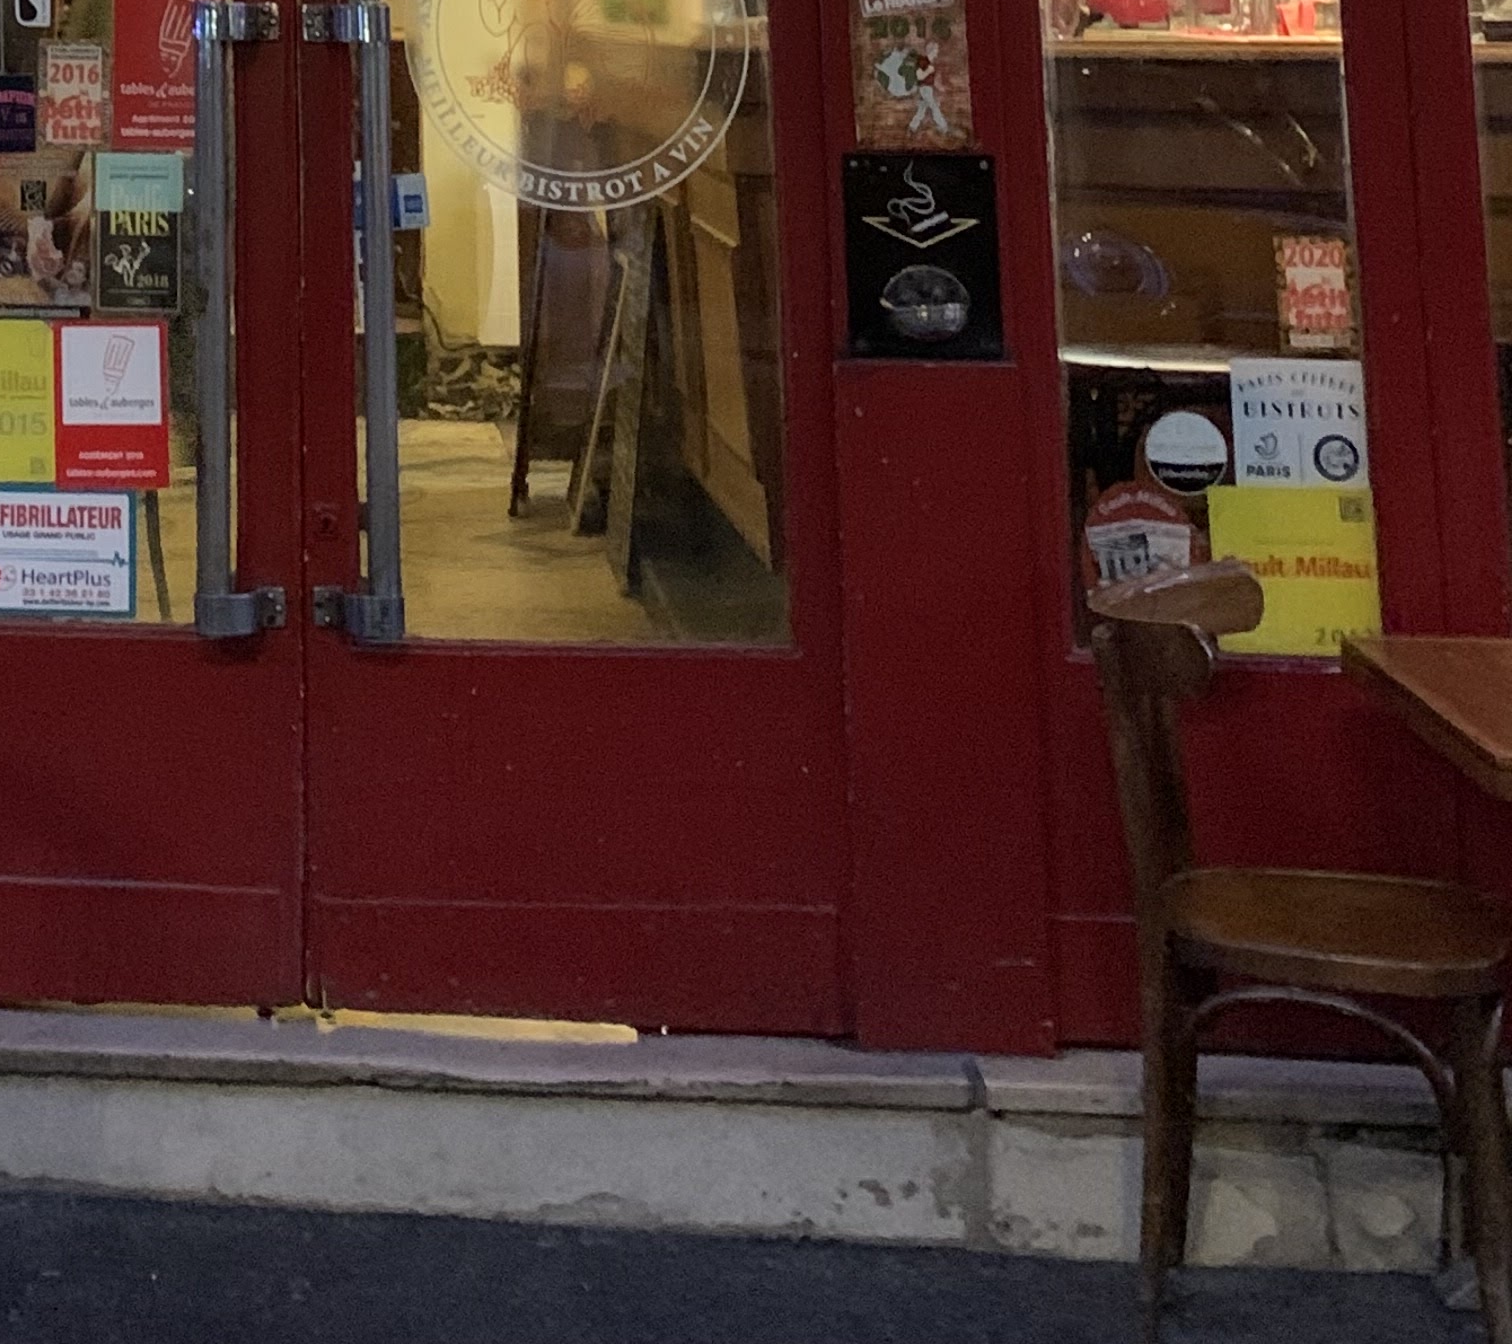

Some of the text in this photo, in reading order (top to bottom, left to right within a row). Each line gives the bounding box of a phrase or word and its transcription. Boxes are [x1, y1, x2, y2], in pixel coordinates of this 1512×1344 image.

[50, 62, 101, 84] 2016
[168, 83, 196, 96] aube
[518, 168, 644, 205] BISTROT
[652, 161, 672, 183] A
[669, 117, 715, 161] VIN
[109, 210, 170, 237] PARIS
[1285, 246, 1345, 269] 2020
[1246, 464, 1291, 478] PARIS
[20, 567, 112, 588] HeartPlus
